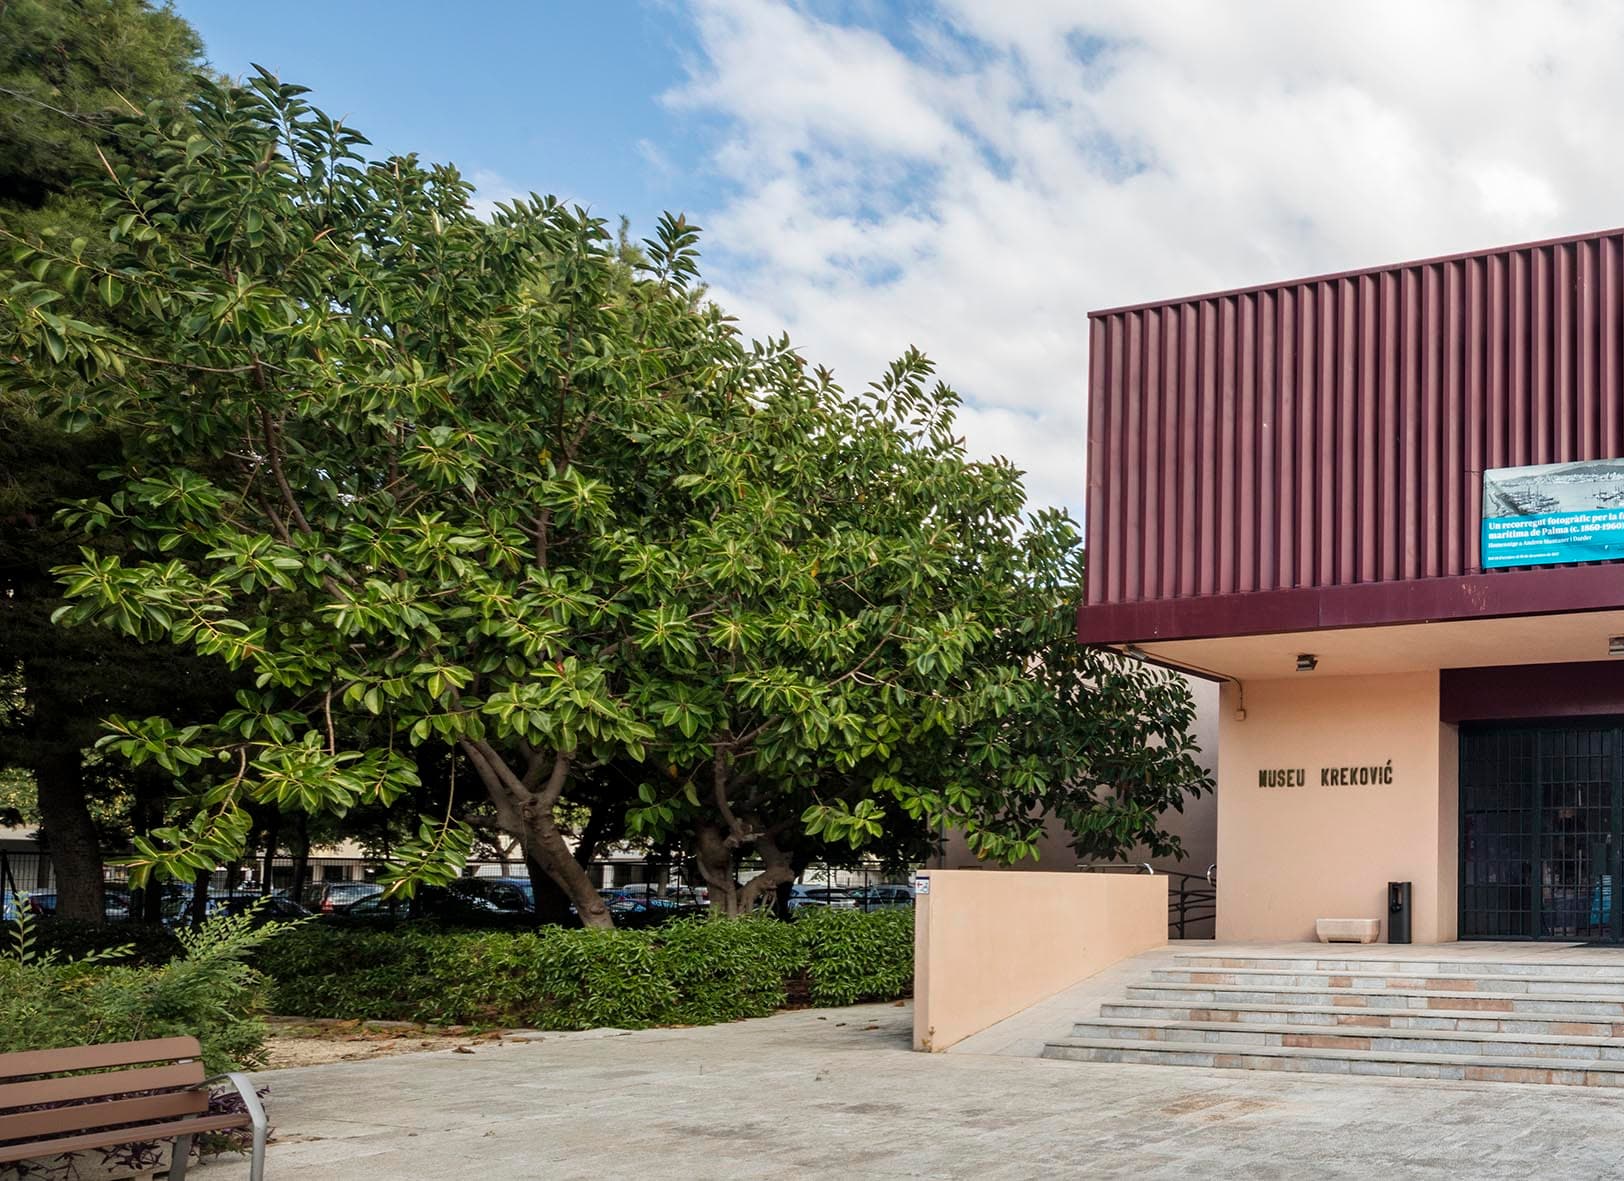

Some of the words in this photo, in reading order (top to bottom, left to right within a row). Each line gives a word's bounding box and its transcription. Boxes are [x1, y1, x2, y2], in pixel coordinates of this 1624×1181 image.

[1488, 521, 1501, 530] Un
[1502, 518, 1546, 529] recorregut
[1547, 514, 1591, 526] fotogràfic
[1592, 514, 1607, 523] per
[1609, 512, 1617, 520] la
[1488, 529, 1529, 540] marítima
[1530, 528, 1541, 537] de
[1542, 526, 1569, 536] Palma
[1569, 525, 1580, 534] (c.
[1581, 521, 1624, 533] 1860-1960)
[1258, 769, 1305, 788] MUSEU
[1321, 759, 1393, 787] KREKOVIĆ
